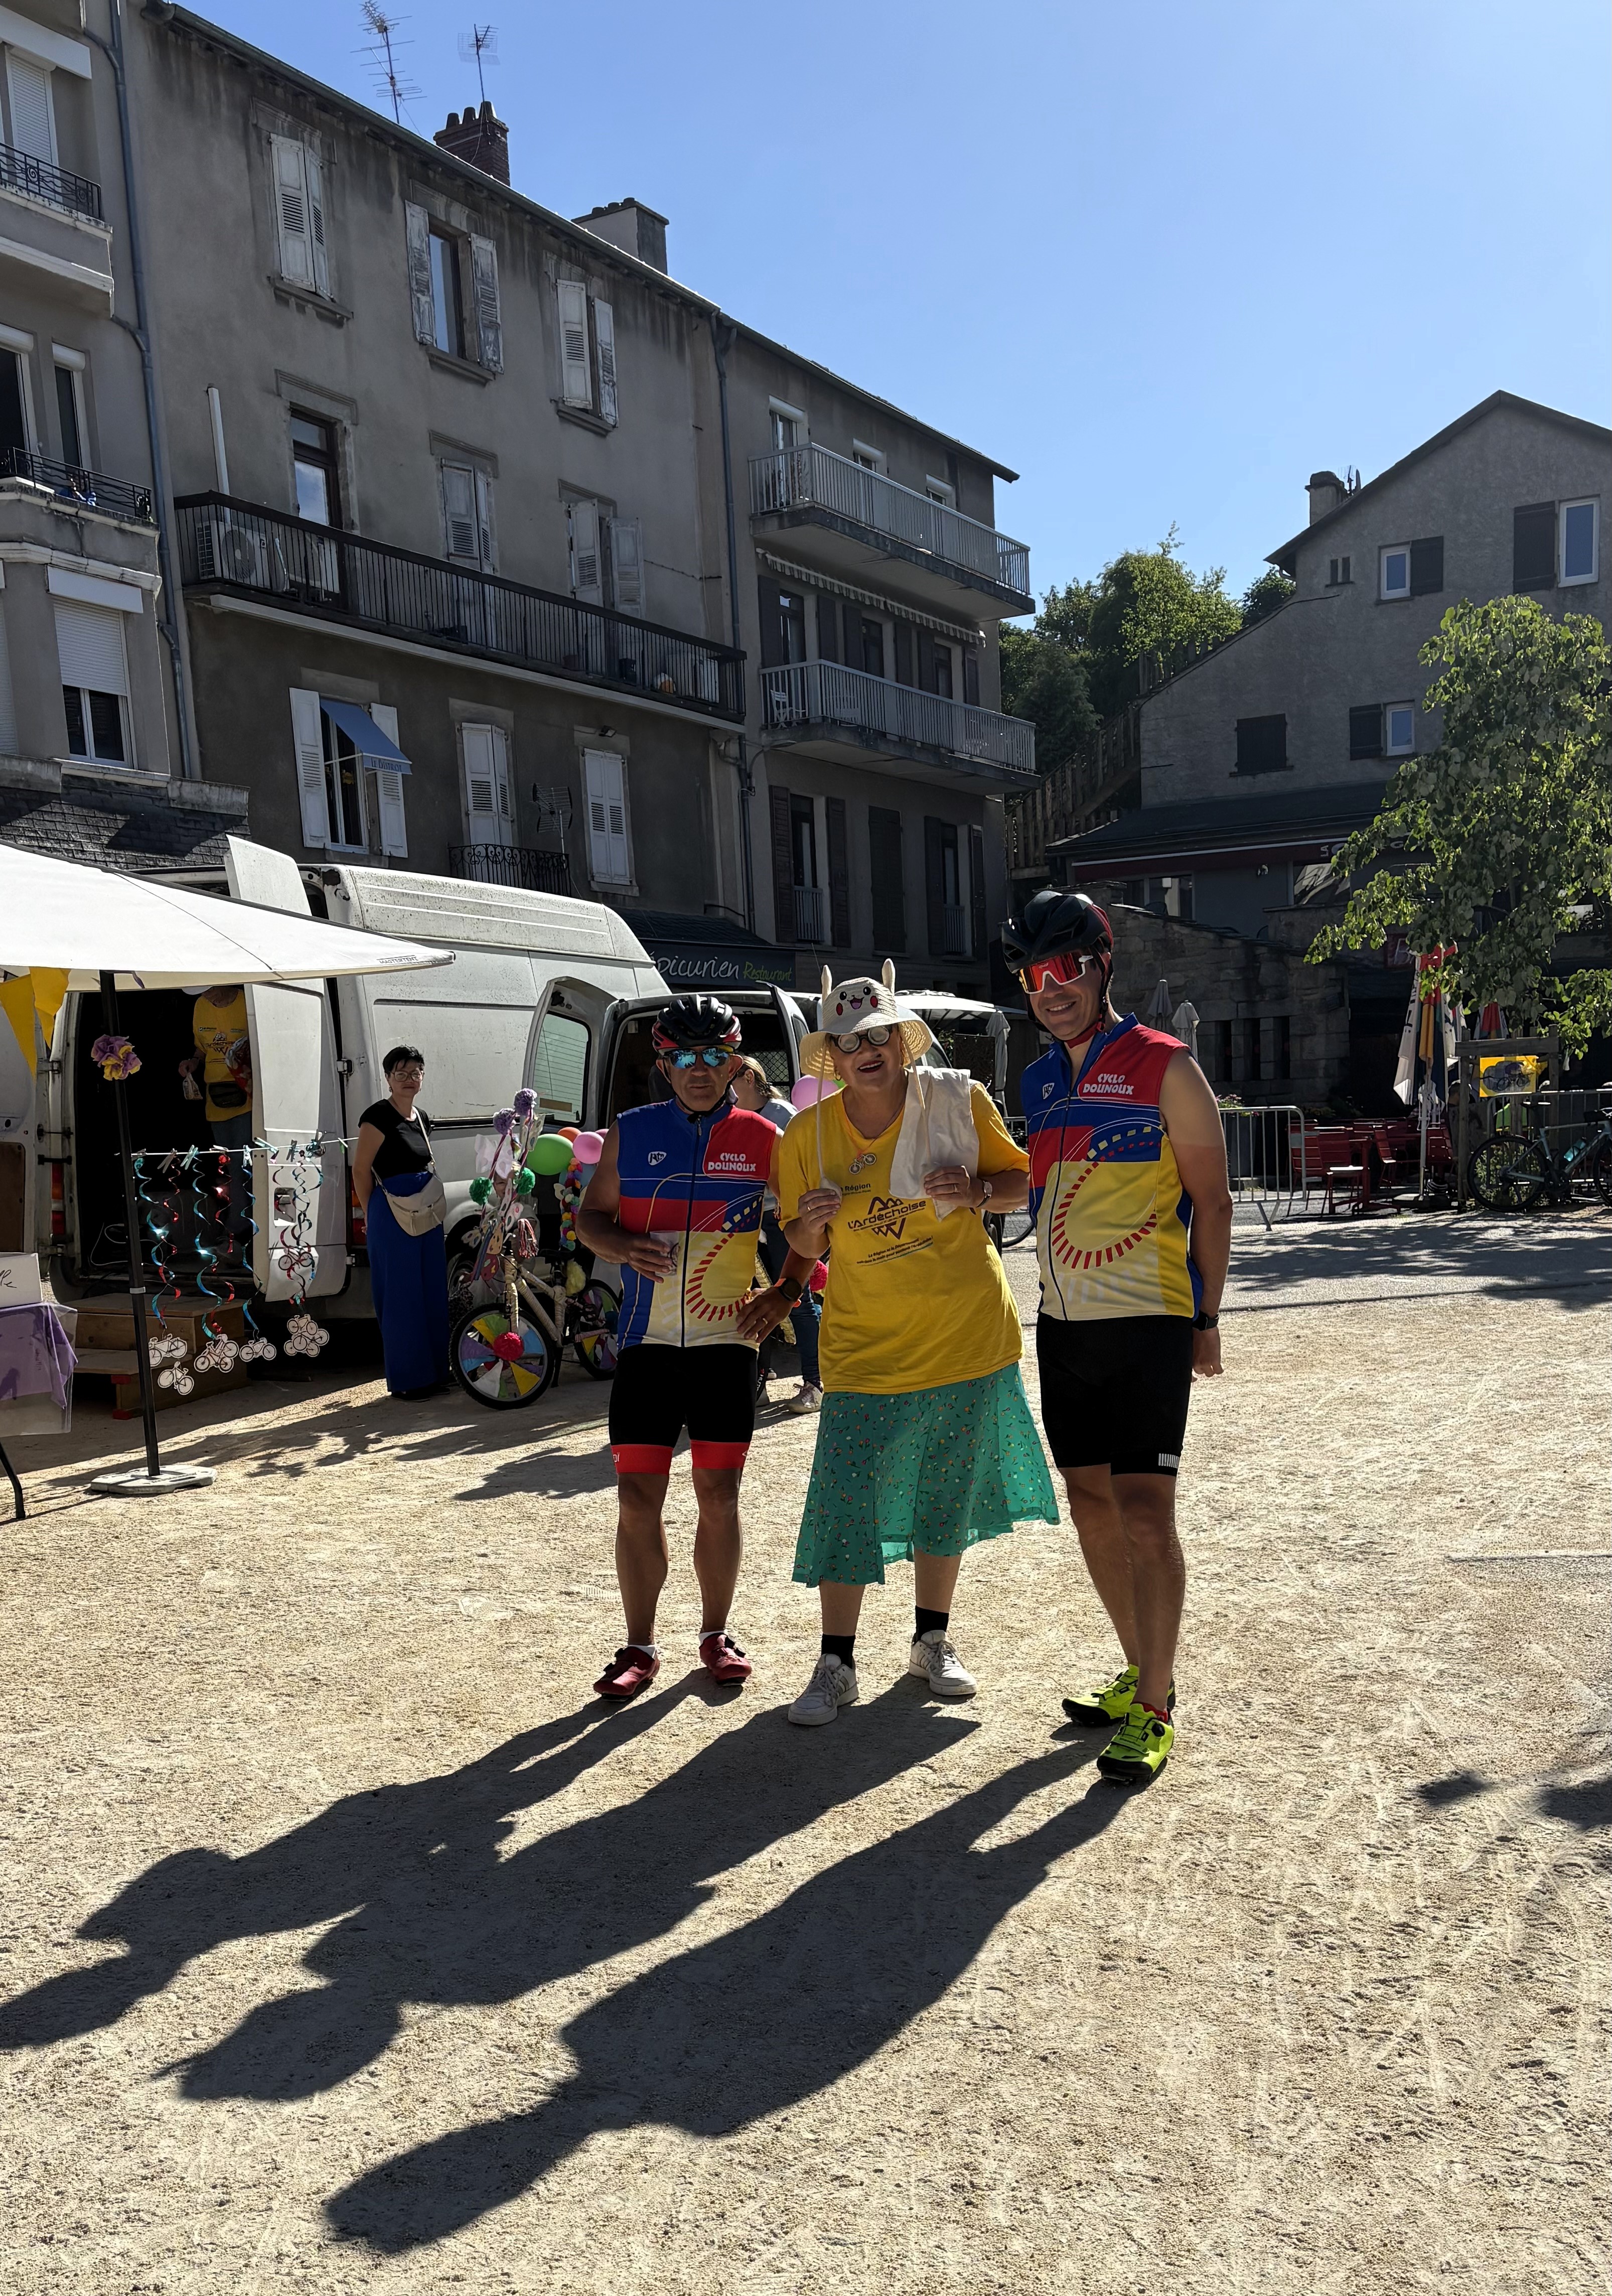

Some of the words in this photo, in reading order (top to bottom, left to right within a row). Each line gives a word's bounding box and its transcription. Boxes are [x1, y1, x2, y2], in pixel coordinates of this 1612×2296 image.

[650, 951, 739, 980] picurien
[743, 961, 792, 982] Restaurant
[1097, 1073, 1125, 1084] CYCLO
[1083, 1084, 1134, 1095] DOUNOUX
[720, 1153, 746, 1161] CYCLO
[708, 1162, 756, 1172] DOUNOUX
[844, 1183, 871, 1191] Région
